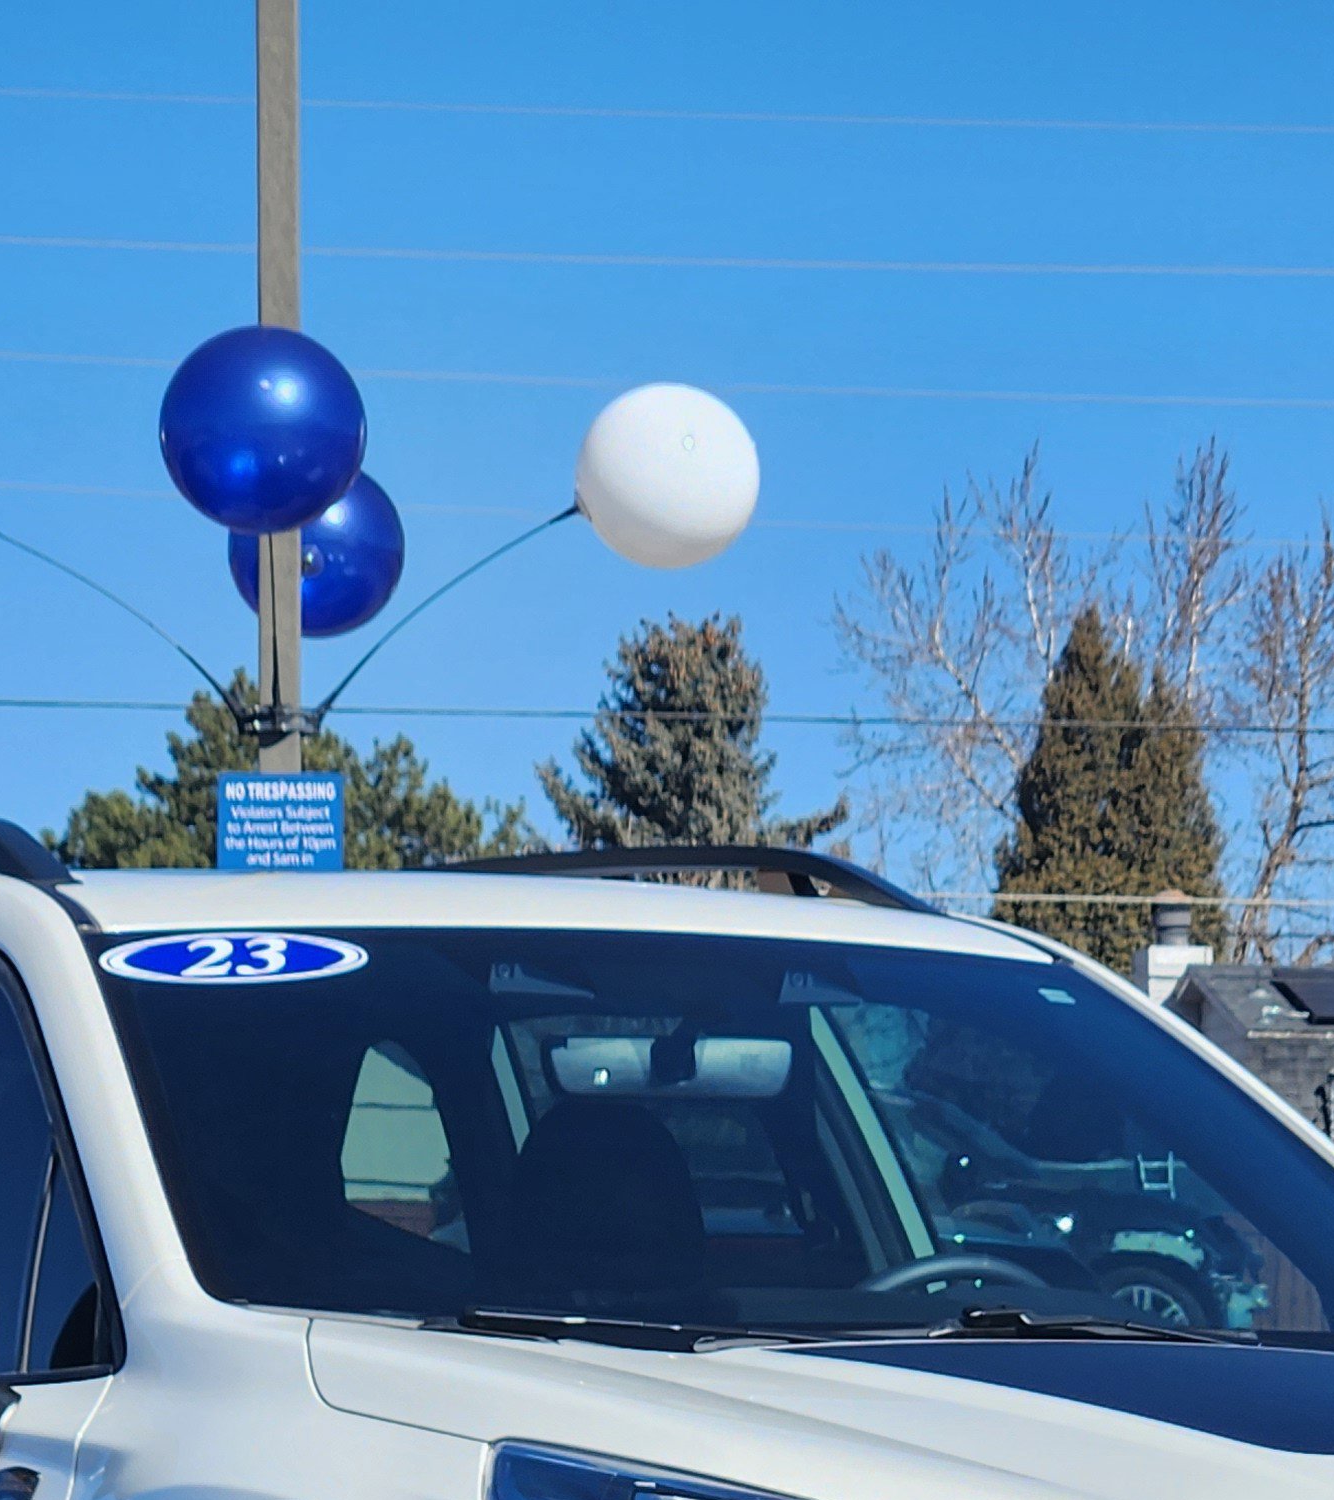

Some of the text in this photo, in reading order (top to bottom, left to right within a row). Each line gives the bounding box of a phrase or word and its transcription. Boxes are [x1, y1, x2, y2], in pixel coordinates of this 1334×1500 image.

[225, 781, 337, 801] NO TRESPASSING
[230, 804, 330, 821] Violators Subject
[227, 821, 335, 835] to Arrest Between
[224, 836, 337, 853] the Hours of 10pm
[246, 851, 270, 866] and
[180, 937, 288, 977] 23
